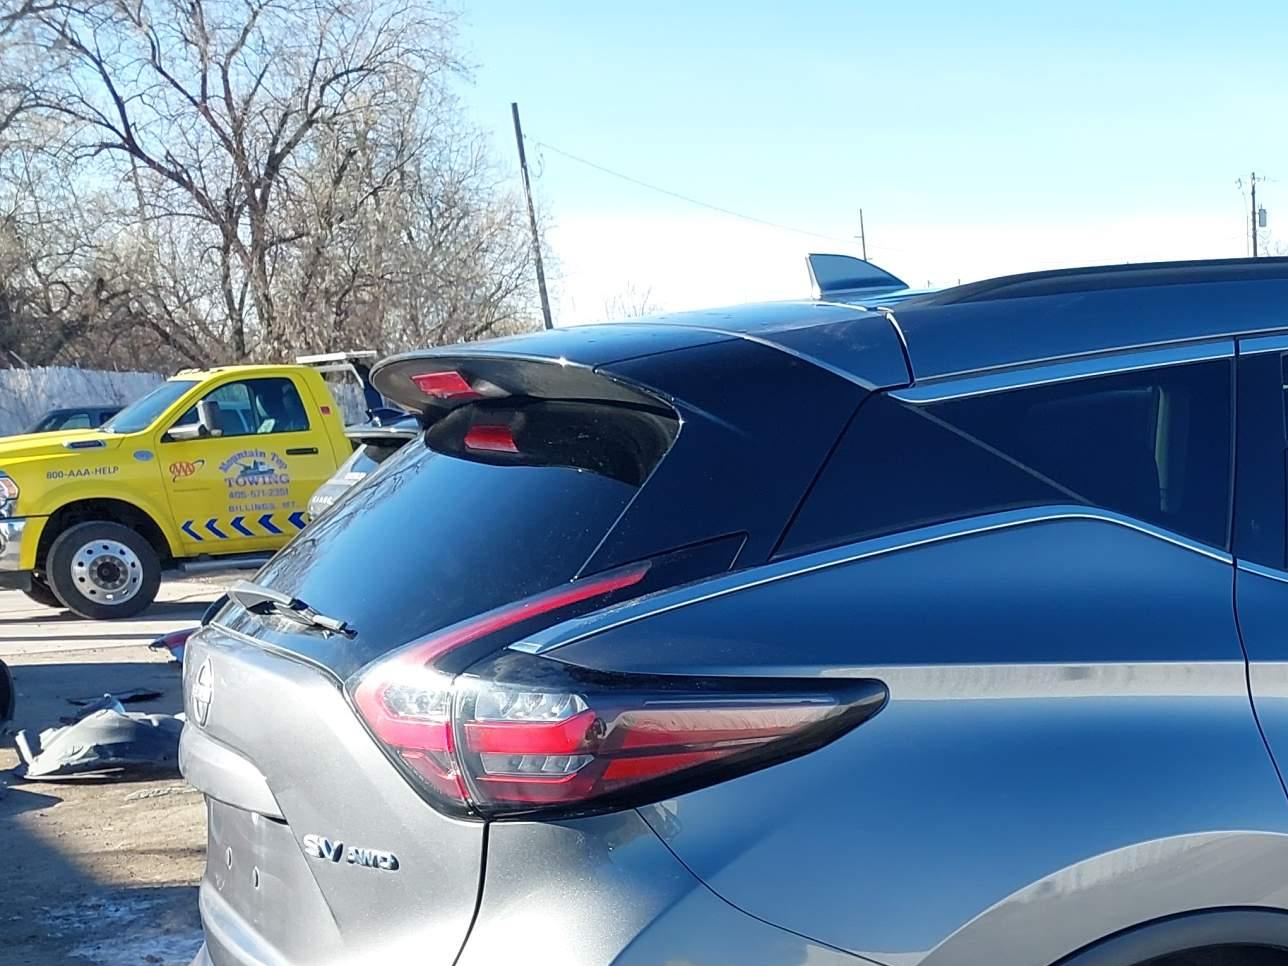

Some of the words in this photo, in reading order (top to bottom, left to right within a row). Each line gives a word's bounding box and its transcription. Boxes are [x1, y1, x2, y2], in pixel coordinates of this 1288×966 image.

[170, 461, 196, 477] AAA
[219, 448, 265, 473] Mountain
[271, 452, 288, 470] Top
[224, 473, 290, 488] TOWING
[303, 833, 344, 864] SV
[346, 846, 401, 872] AWD
